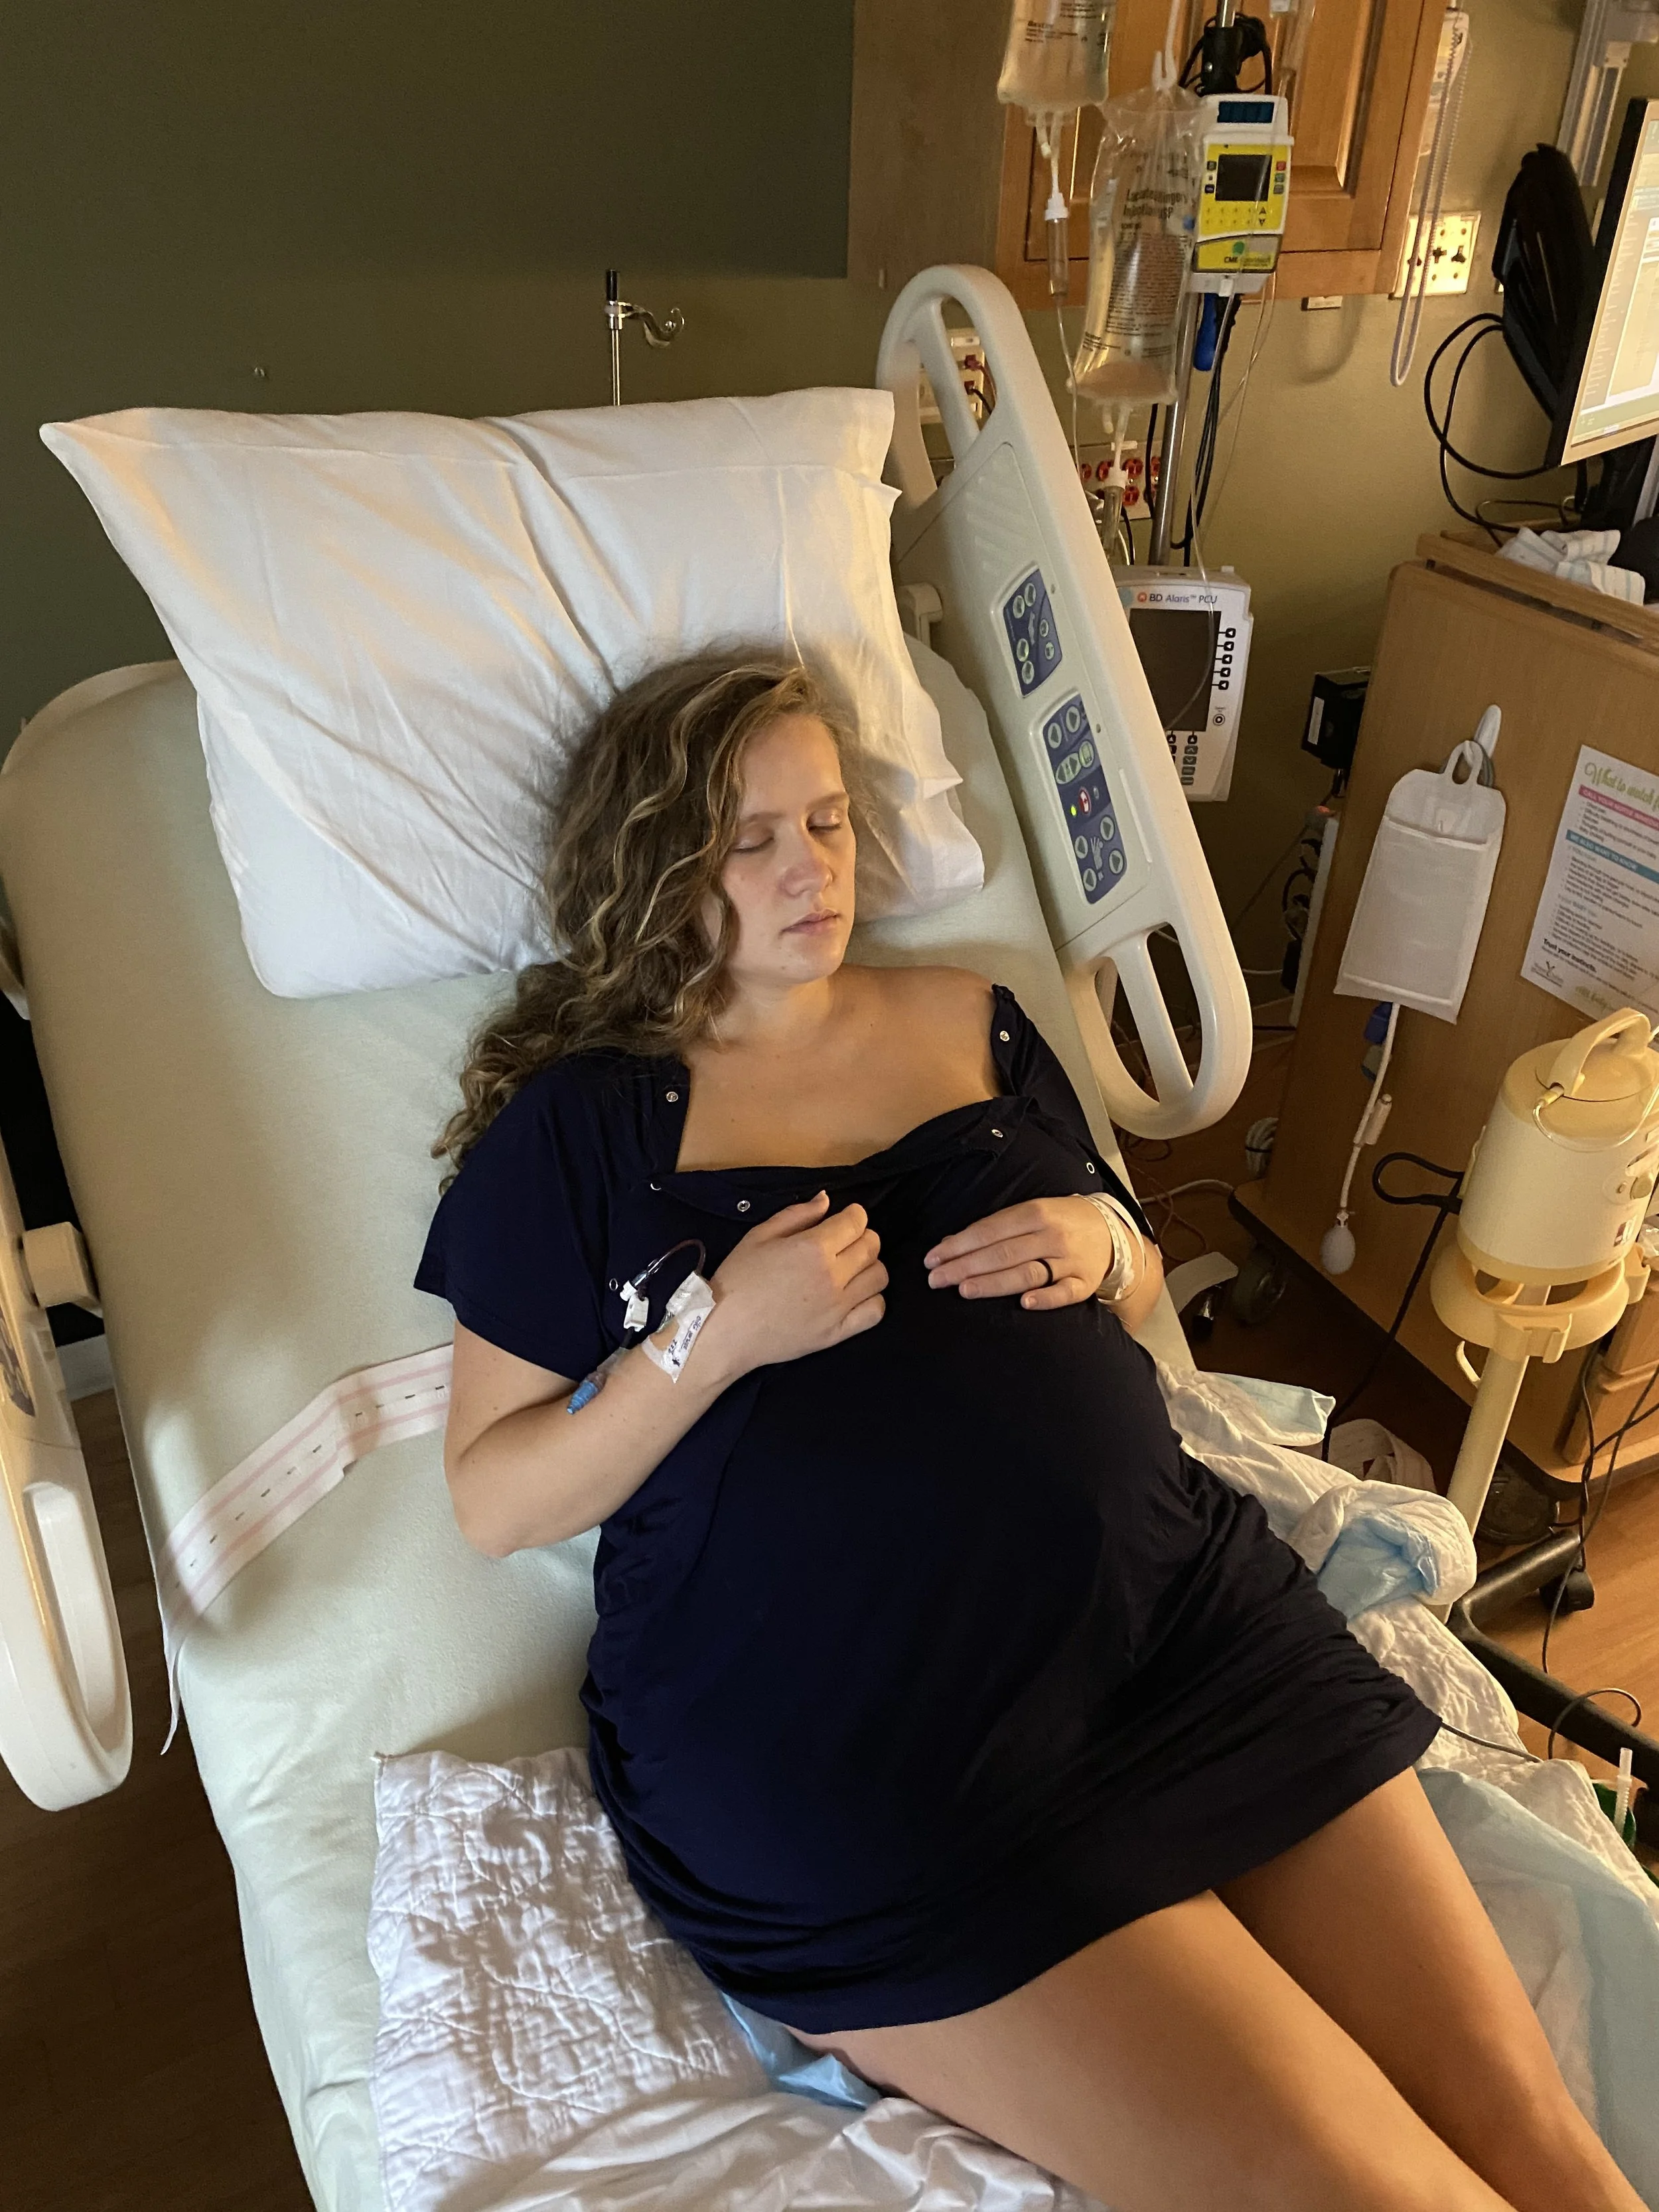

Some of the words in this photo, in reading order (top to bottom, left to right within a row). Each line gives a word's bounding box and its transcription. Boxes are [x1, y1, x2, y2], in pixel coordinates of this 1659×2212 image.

[1198, 595, 1218, 604] PCU
[1544, 938, 1557, 950] Trust
[1557, 948, 1571, 959] your
